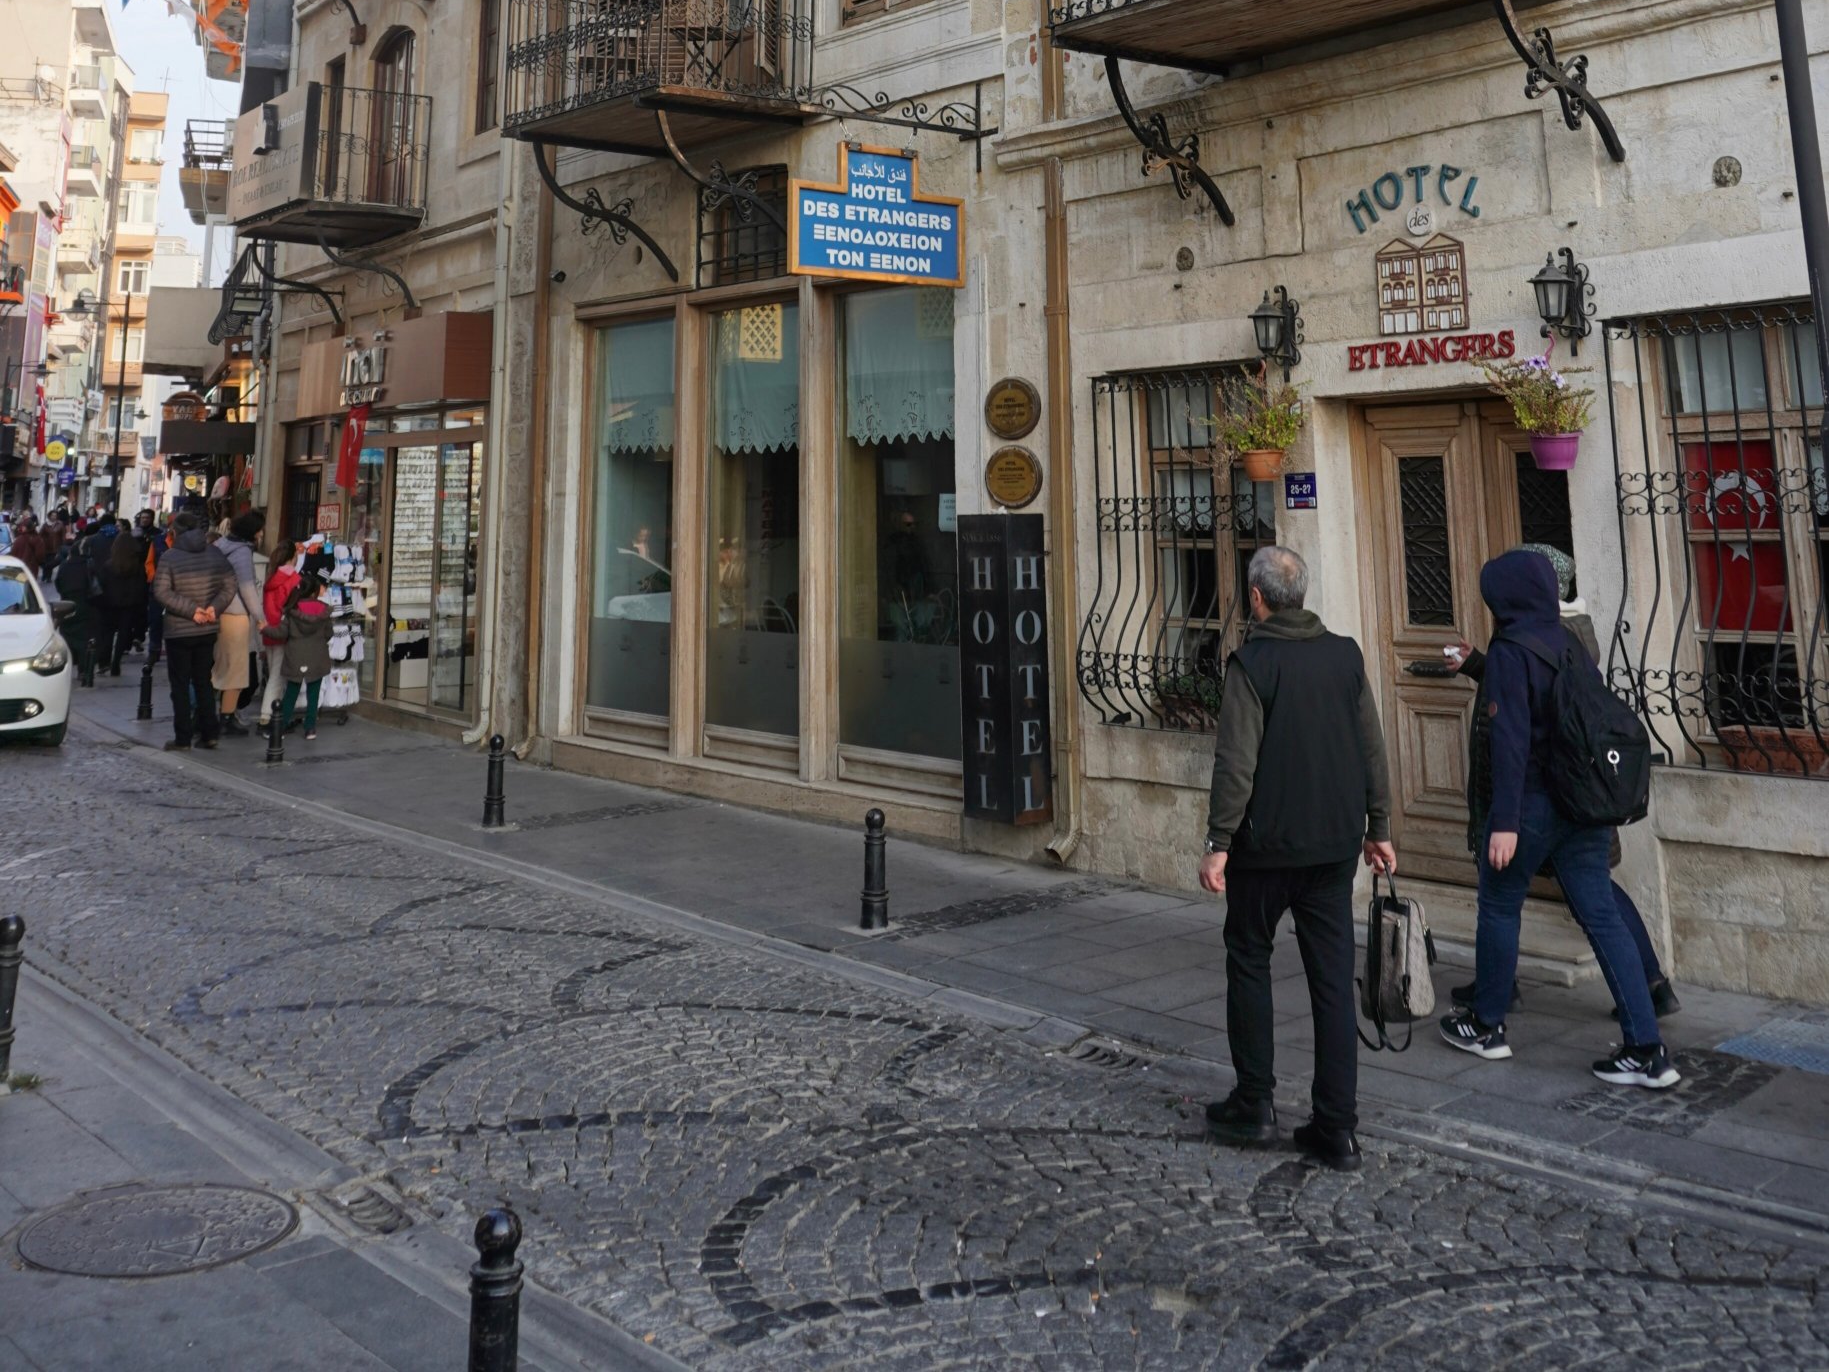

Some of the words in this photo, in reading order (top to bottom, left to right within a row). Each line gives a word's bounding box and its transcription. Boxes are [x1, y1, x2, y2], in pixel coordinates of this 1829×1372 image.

[851, 161, 885, 179] للأجانب
[887, 168, 907, 183] فندق
[851, 182, 907, 204] HOTEL
[1346, 164, 1481, 234] HOTEL
[803, 199, 840, 219] DES
[844, 204, 952, 231] ETRANGERS
[1408, 211, 1431, 229] des
[1347, 329, 1516, 372] ETRANGERS
[1290, 484, 1311, 495] 25-27
[970, 556, 999, 811] HOTEL
[1014, 556, 1045, 812] HOTEL
